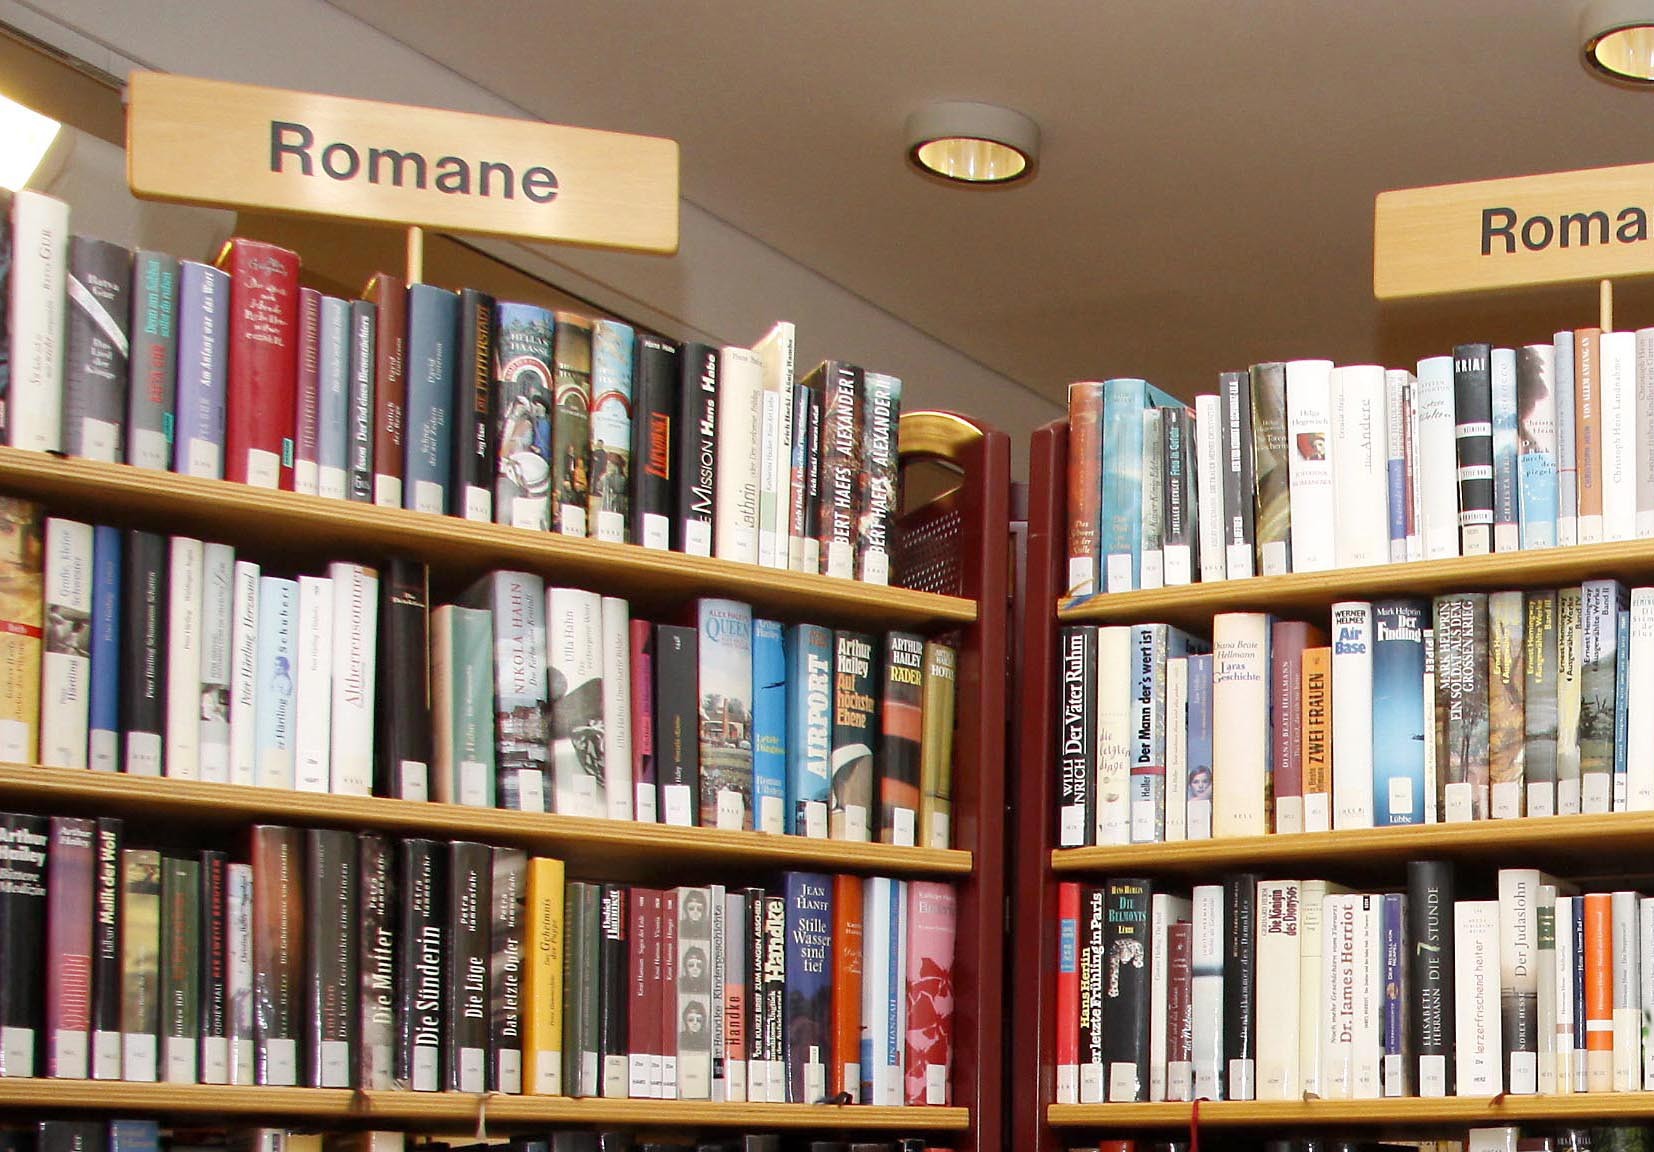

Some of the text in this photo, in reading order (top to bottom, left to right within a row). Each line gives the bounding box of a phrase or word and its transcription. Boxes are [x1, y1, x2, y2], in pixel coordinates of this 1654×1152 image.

[269, 120, 559, 204] Romane
[691, 354, 716, 516] MISSION Hans Habe
[1140, 629, 1152, 645] ist
[1334, 609, 1366, 618] WERNER
[1339, 627, 1361, 642] Air
[1398, 616, 1418, 629] Der
[1140, 645, 1152, 675] wert
[1335, 640, 1367, 656] Base
[1439, 602, 1450, 690] MARK HELPRIN
[1450, 601, 1462, 721] EIN SOLDAT ALS DEM
[1462, 600, 1474, 692] GROSSEN KRIEG
[807, 654, 829, 780] AIRPORT
[1065, 635, 1083, 755] Der Väter Ruhm
[1139, 705, 1151, 741] Mann
[1309, 673, 1324, 763] ZWEI FRAUEN
[1063, 759, 1073, 796] WILLI
[1139, 742, 1150, 763] Der
[793, 933, 831, 947] Wasser
[799, 918, 827, 935] Stille
[1268, 890, 1285, 933] Die Königin
[1283, 886, 1298, 936] des Dionysos
[1515, 881, 1529, 977] Der Judaslohn
[765, 900, 784, 983] Handke
[801, 946, 825, 959] sind
[416, 926, 441, 1046] Die Sünderin
[465, 957, 485, 1019] Die Lüge
[502, 937, 519, 1036] Das letzte Opfer
[1340, 903, 1353, 1043] Dr. James Herriot
[728, 994, 741, 1047] Handke
[1423, 988, 1431, 1046] ELISABETH
[1433, 988, 1441, 1046] HERRMANN
